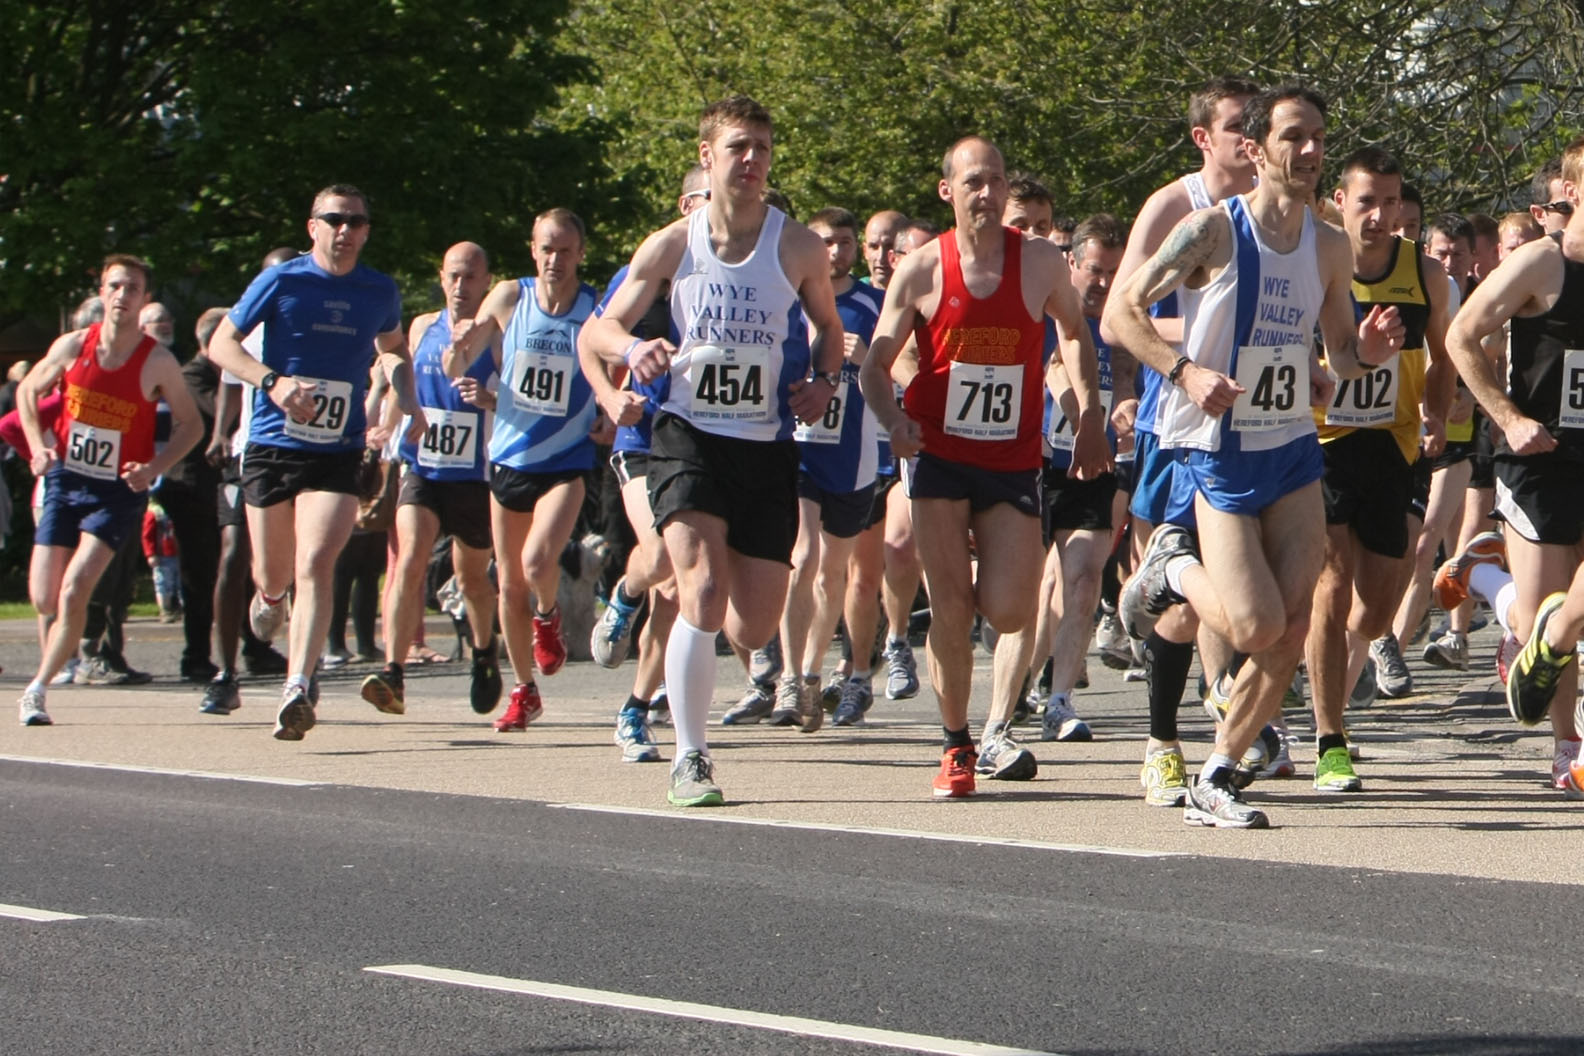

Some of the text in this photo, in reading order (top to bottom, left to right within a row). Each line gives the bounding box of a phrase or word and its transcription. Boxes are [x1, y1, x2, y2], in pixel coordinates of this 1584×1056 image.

[709, 283, 757, 302] WYE
[1263, 276, 1290, 298] WYE
[692, 305, 772, 325] VALLEY
[1260, 303, 1304, 327] VALLEY
[525, 338, 571, 353] BRECON
[688, 326, 775, 346] RUNNERS
[519, 367, 564, 402] 491
[696, 364, 764, 405] 454
[1251, 365, 1296, 411] 43
[291, 395, 346, 430] 29
[957, 381, 1013, 423] 713
[70, 433, 113, 468] 502
[423, 423, 472, 456] 487
